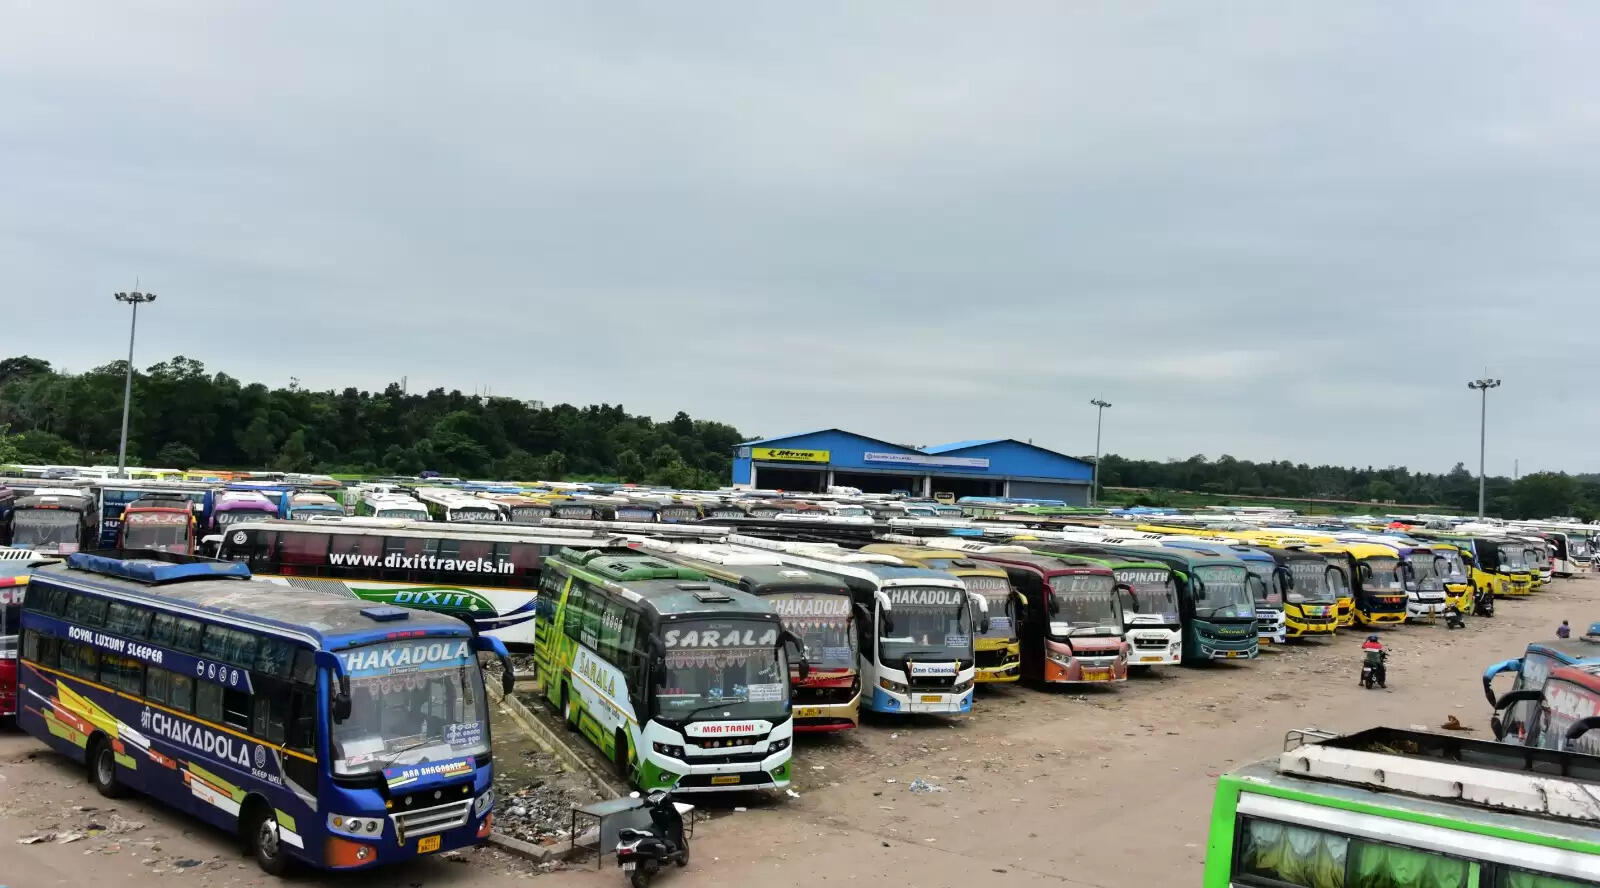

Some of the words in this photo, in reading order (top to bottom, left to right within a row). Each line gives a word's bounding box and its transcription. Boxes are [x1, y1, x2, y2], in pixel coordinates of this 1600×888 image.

[450, 511, 496, 521] SANSKAR
[329, 553, 515, 574] www.dixittravels.in
[394, 591, 469, 606] DIXIT
[770, 600, 850, 615] HAKADOLA
[68, 626, 93, 643] ROYAL
[95, 633, 125, 652] LUXURY
[127, 642, 163, 664] SLEEPER
[664, 629, 777, 648] SARALA
[341, 641, 470, 671] HAKADOLA
[579, 652, 616, 697] SARALA
[725, 724, 754, 732] TARINI
[152, 714, 250, 768] CHAKADOLA
[251, 767, 268, 778] SLEEP
[268, 772, 282, 785] WELL
